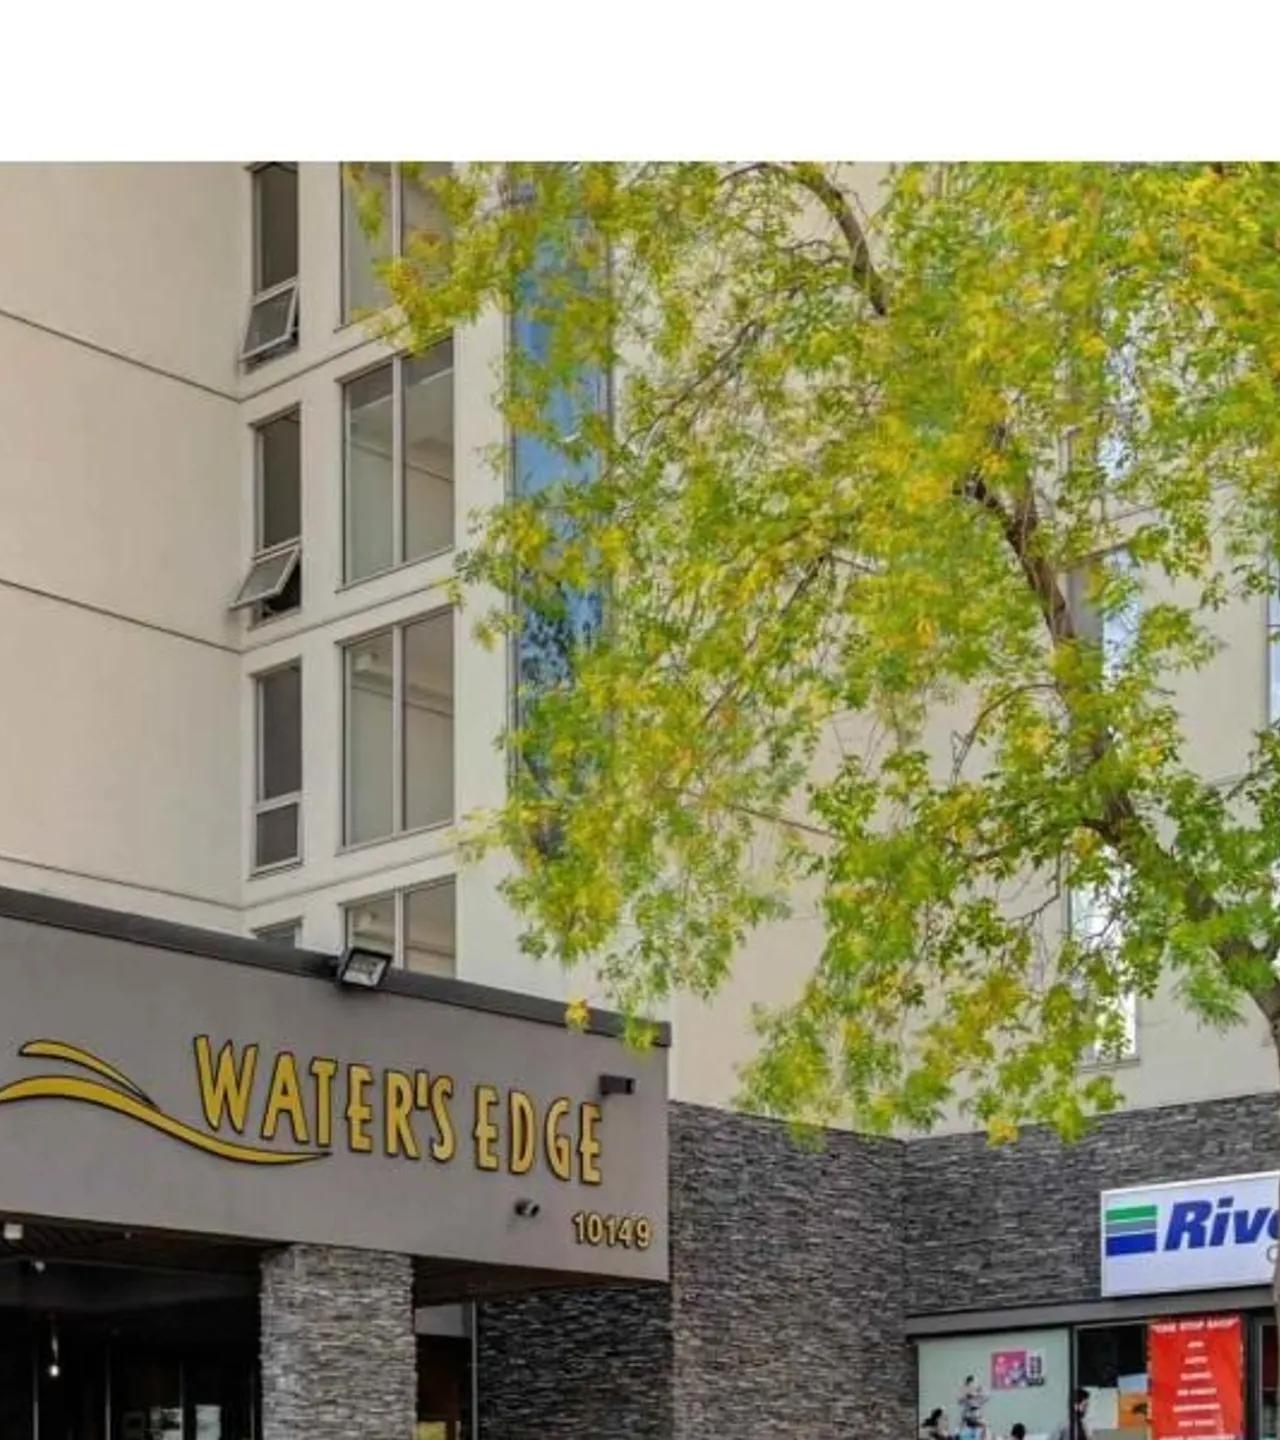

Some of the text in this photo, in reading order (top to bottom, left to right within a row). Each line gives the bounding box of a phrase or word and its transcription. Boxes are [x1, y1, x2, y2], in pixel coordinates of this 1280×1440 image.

[192, 1034, 603, 1185] WATER'S EDGE
[571, 1209, 652, 1251] 10149
